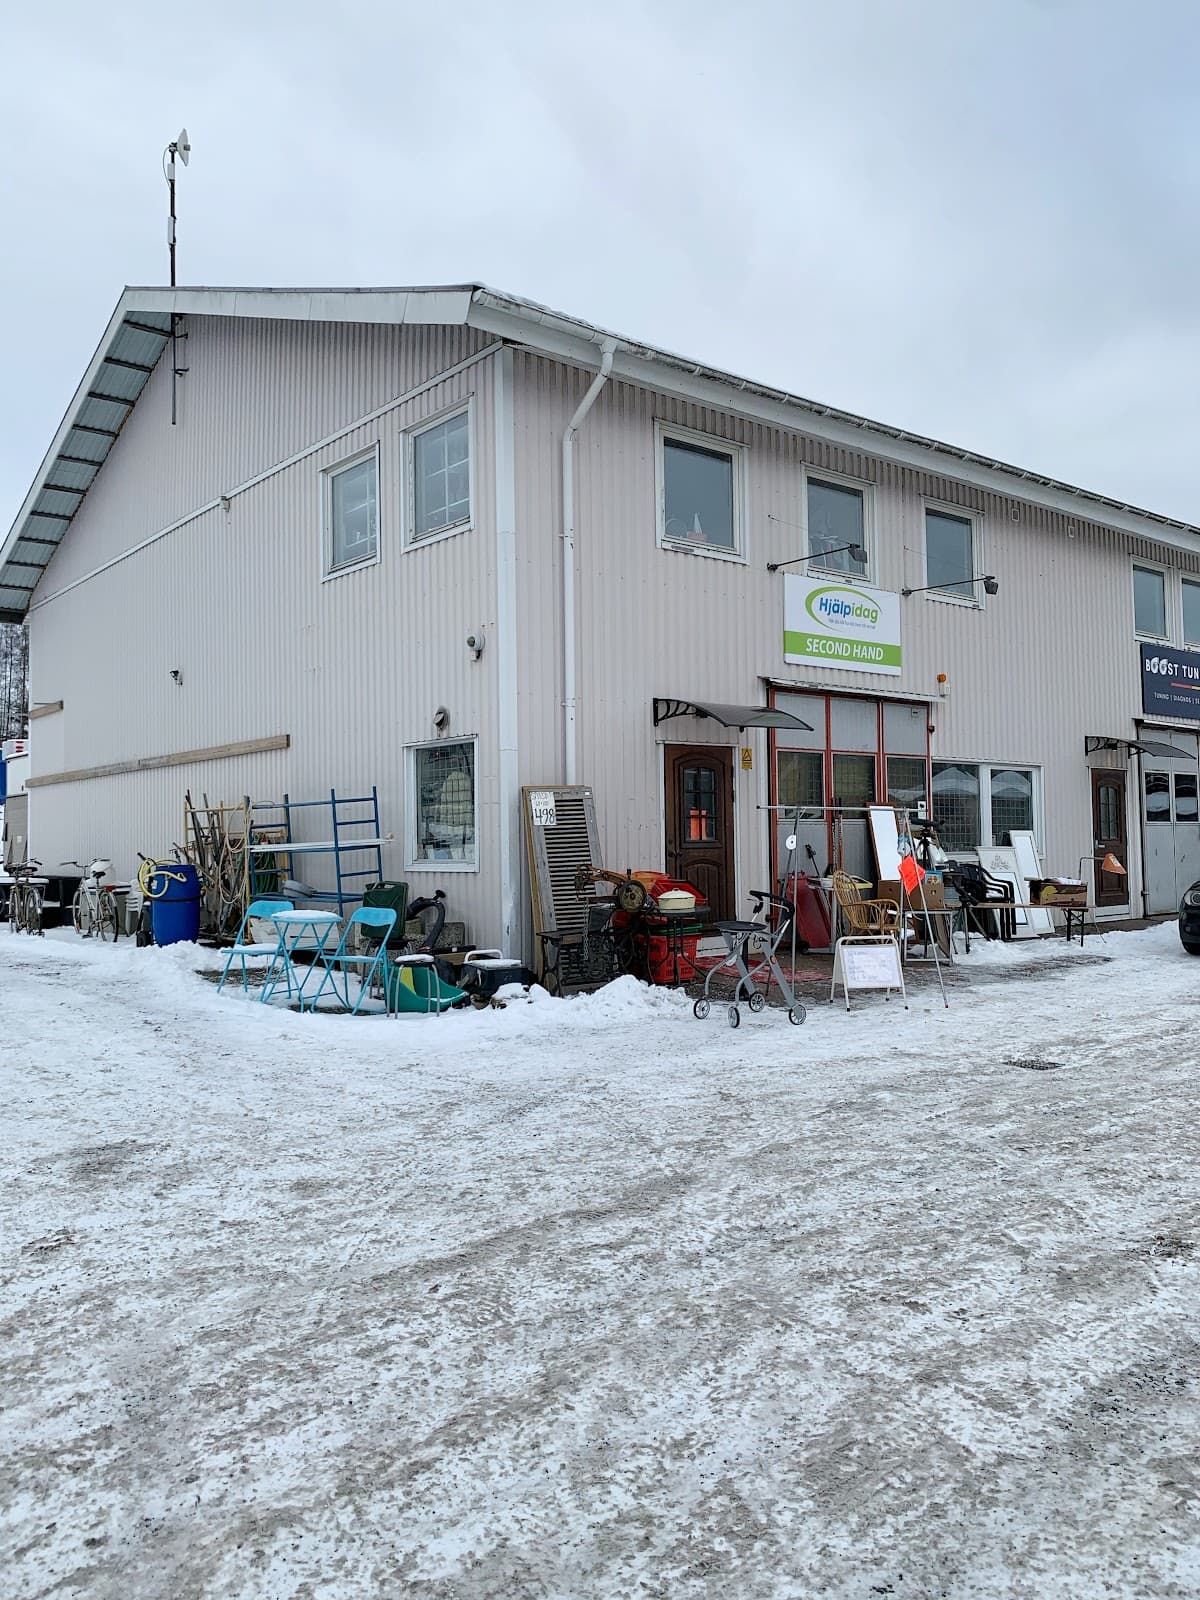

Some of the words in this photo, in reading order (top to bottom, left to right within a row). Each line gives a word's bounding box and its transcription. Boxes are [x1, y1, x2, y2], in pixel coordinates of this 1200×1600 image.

[819, 597, 879, 624] Hjälpidag
[806, 638, 851, 656] SECOND
[853, 644, 884, 660] HAND
[1145, 657, 1179, 676] BOOST
[1182, 665, 1200, 680] TUN
[535, 808, 555, 824] 498
